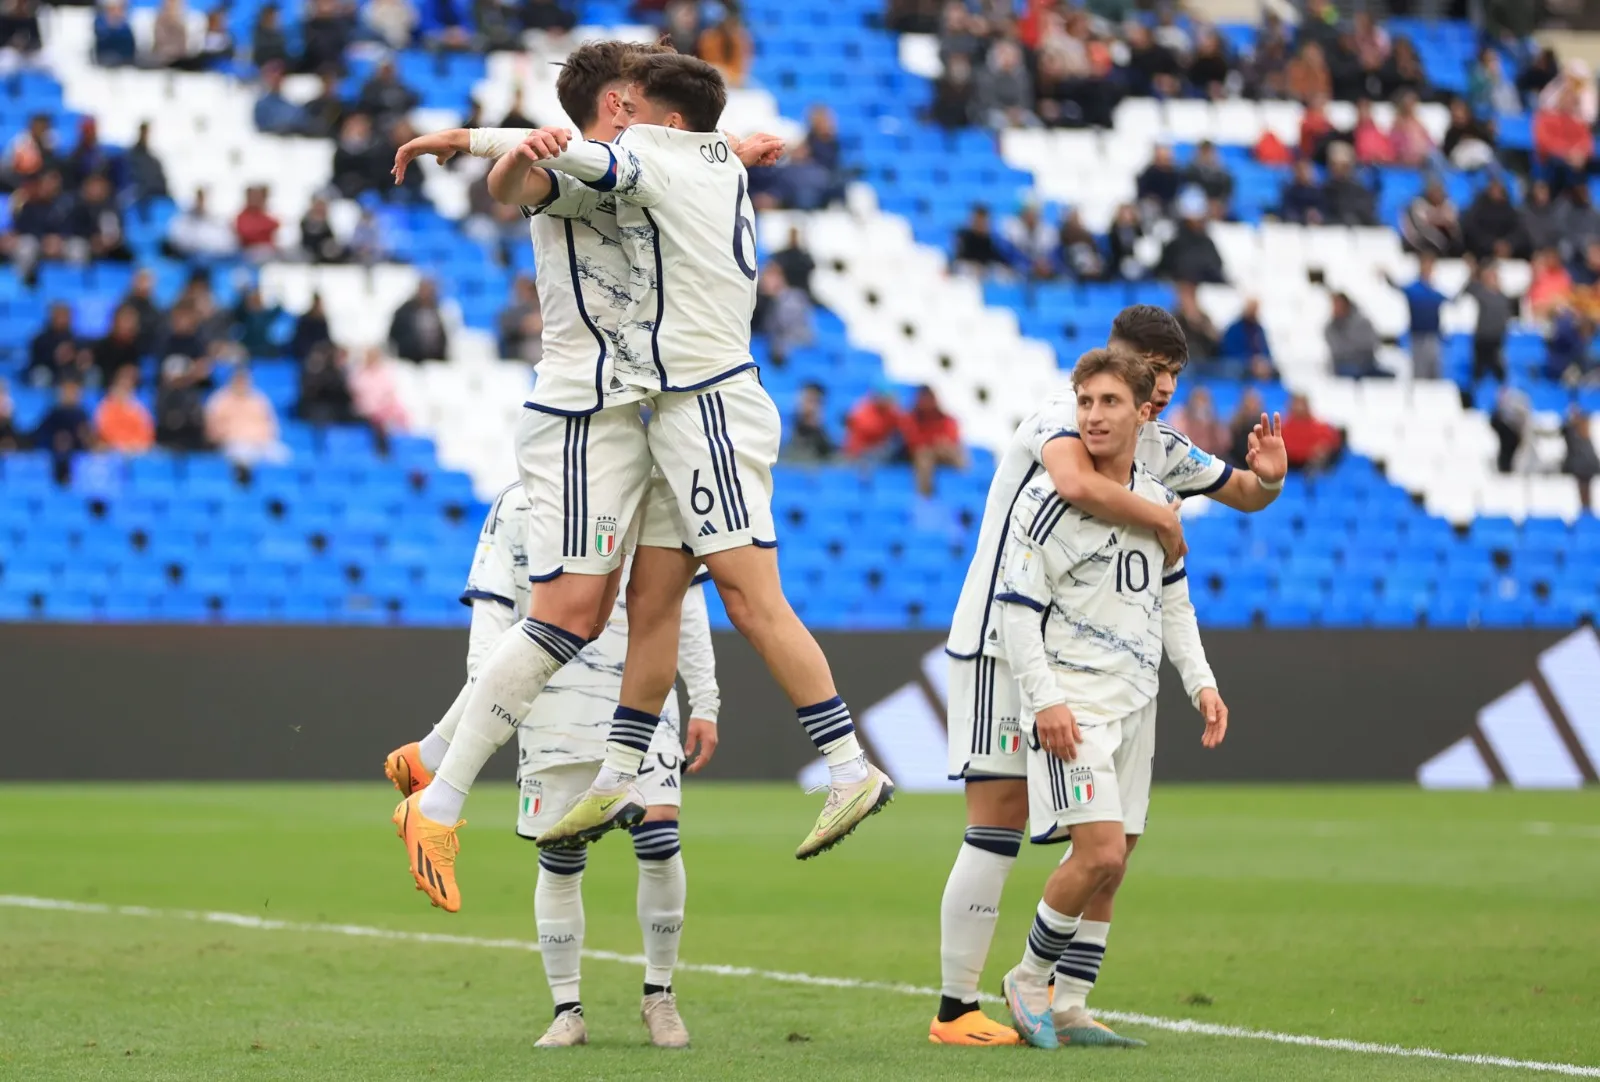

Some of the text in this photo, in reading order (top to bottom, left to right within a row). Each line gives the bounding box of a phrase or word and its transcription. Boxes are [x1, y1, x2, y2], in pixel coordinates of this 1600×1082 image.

[700, 140, 730, 163] GIO
[733, 173, 756, 281] 6
[691, 468, 715, 515] 6
[1116, 550, 1149, 592] 10
[540, 934, 576, 944] ITALIA
